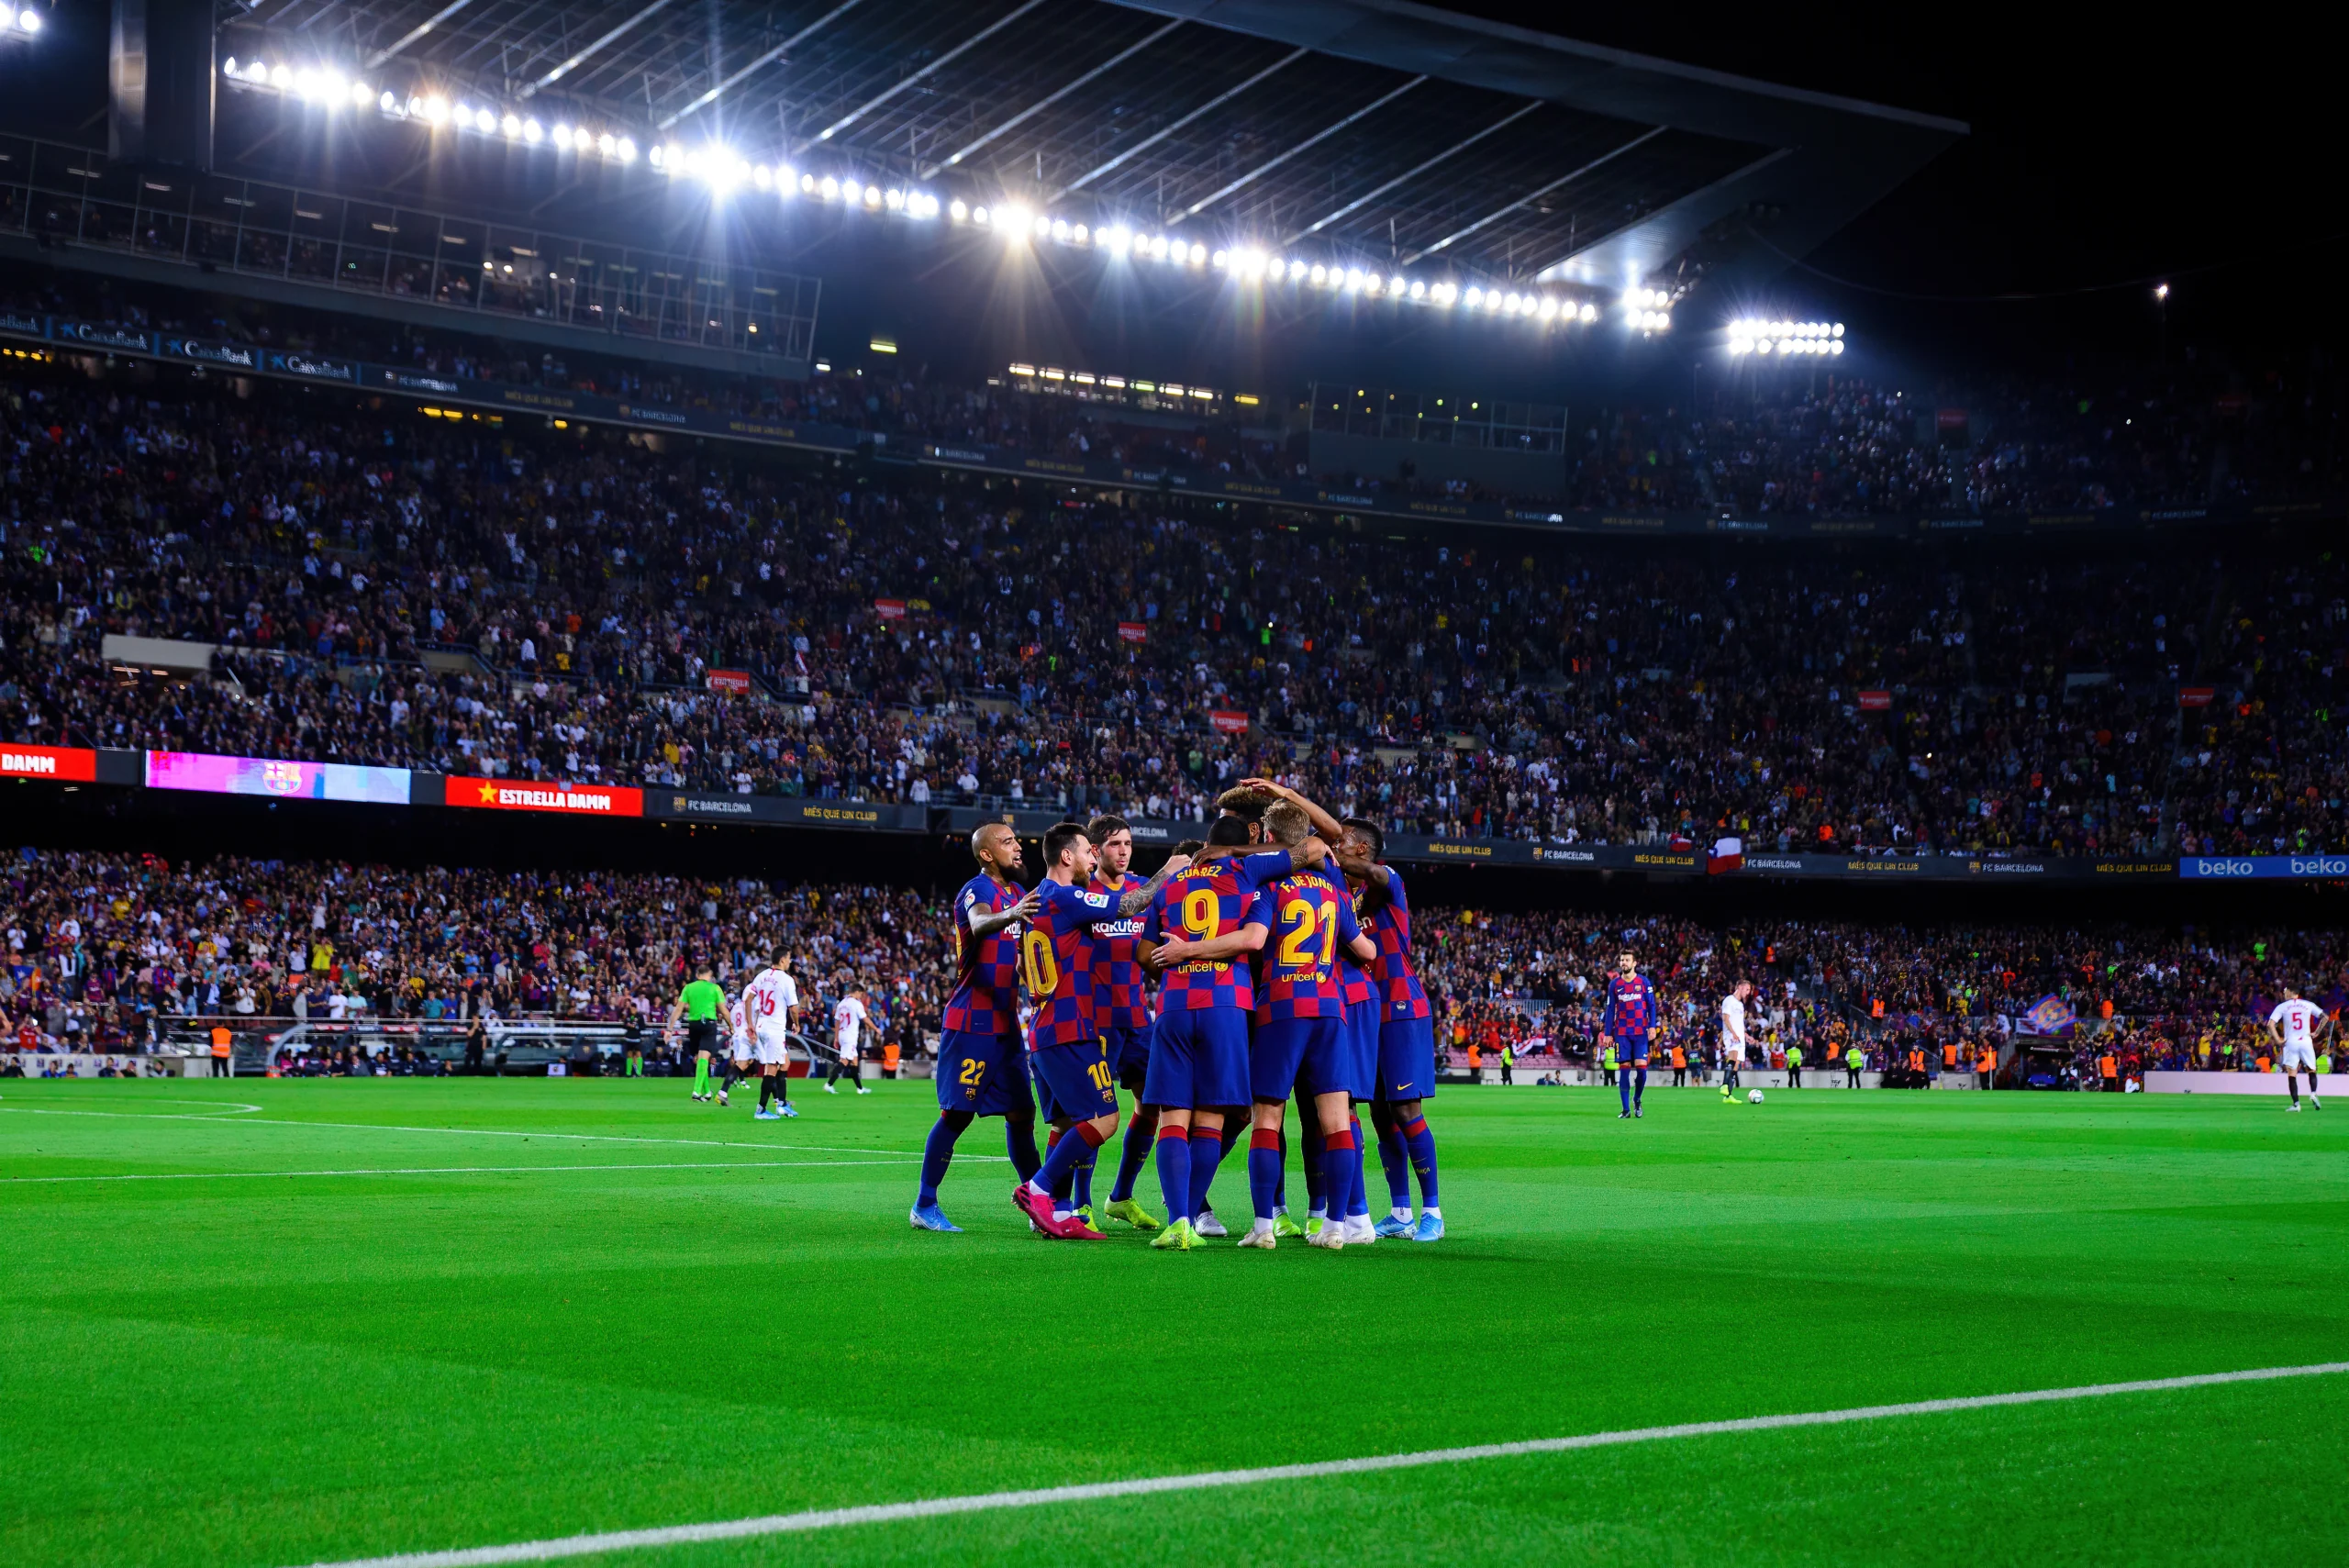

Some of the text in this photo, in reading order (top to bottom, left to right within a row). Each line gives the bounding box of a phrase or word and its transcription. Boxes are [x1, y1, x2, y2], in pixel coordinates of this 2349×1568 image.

[79, 324, 148, 350] CaixaBank
[184, 340, 252, 366] CaixaBank
[1, 753, 56, 773] DAMM
[498, 788, 611, 811] ESTRELLA DAMM
[687, 799, 752, 814] FC BARCELONA
[823, 808, 841, 819] QUE
[841, 809, 854, 820] UN
[855, 811, 878, 822] CLUB
[1130, 826, 1168, 838] ARCELONA
[1445, 844, 1460, 855] QUE
[1461, 845, 1472, 855] UN
[1473, 846, 1492, 857] CLUB
[1543, 849, 1595, 862] FC BARCELONA
[1747, 859, 1802, 869] FC BARCELONA
[2199, 859, 2254, 875] beko
[2291, 858, 2346, 874] beko
[1280, 875, 1333, 894] F. DE JONG
[1182, 888, 1219, 940] 9
[1091, 919, 1145, 934] Rakuten
[1278, 899, 1336, 966] 21
[1177, 961, 1213, 973] unicef
[1281, 971, 1316, 983] unicef
[759, 989, 775, 1016] 16
[736, 1012, 741, 1027] 8
[2292, 1012, 2302, 1030] 5
[959, 1058, 986, 1085] 22
[1086, 1061, 1112, 1090] 10
